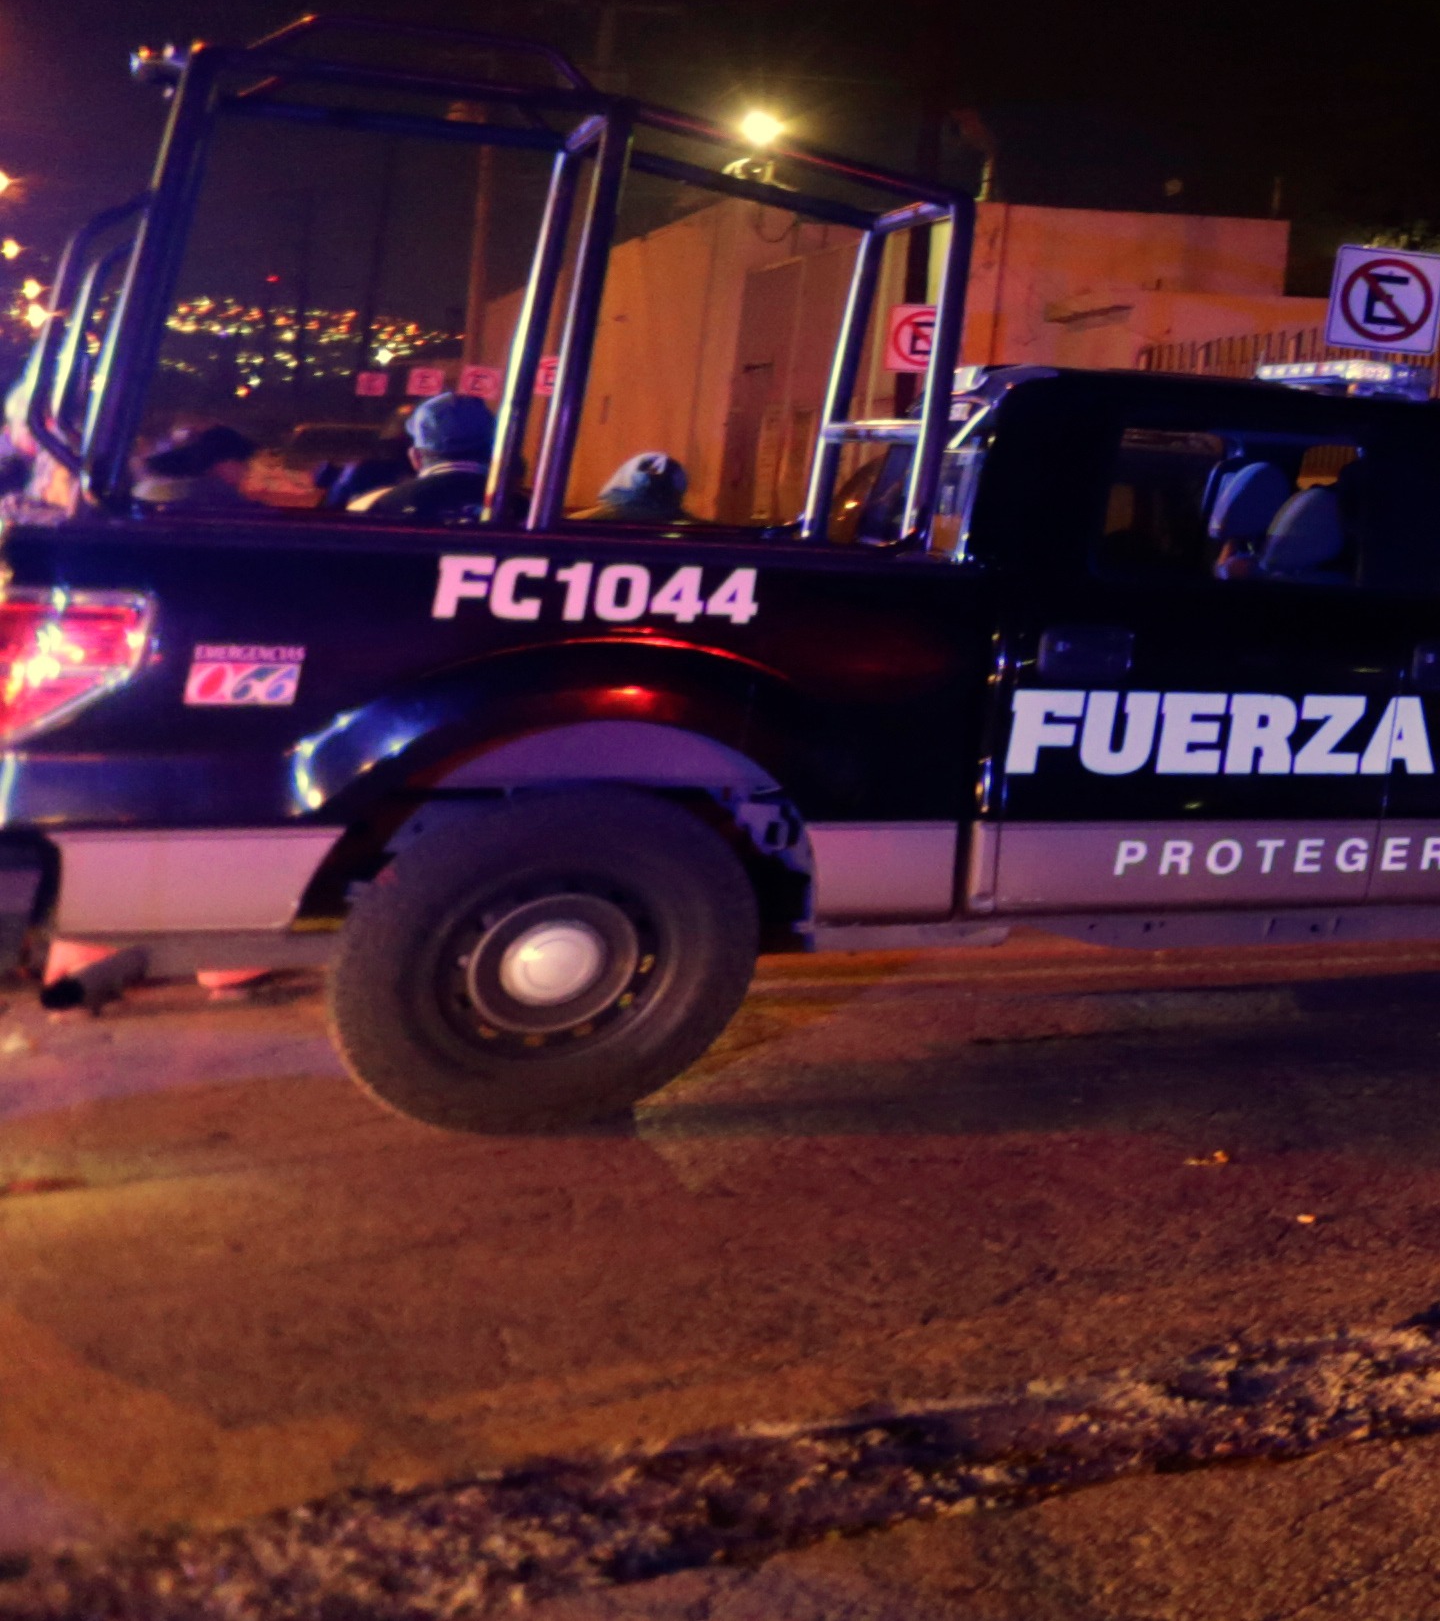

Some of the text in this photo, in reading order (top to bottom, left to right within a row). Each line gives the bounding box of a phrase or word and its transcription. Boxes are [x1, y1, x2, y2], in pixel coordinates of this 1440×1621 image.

[431, 555, 758, 624] FC1044
[186, 663, 299, 705] 066
[1005, 689, 1435, 775] FUERZA
